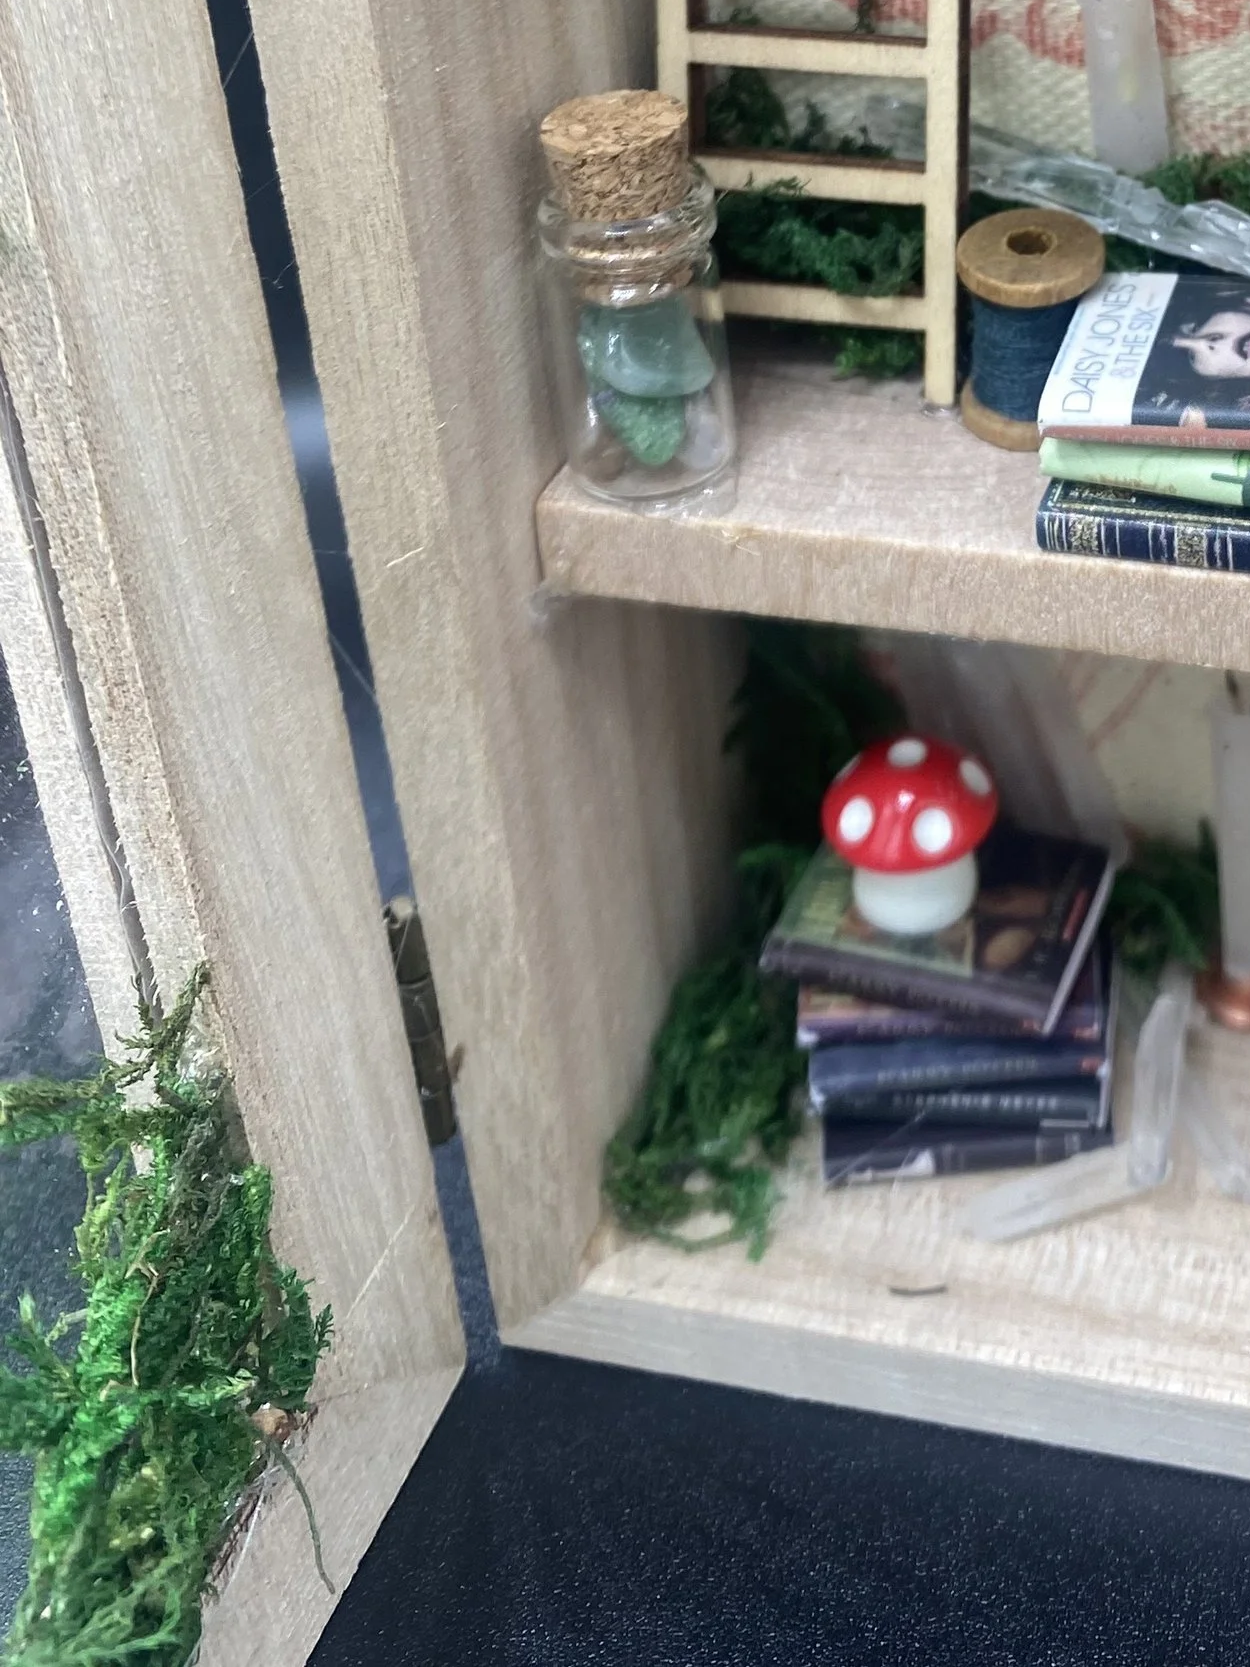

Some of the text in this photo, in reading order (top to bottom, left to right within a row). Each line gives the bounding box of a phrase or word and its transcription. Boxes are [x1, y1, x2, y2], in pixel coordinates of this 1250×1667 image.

[1061, 348, 1109, 414] DAISY
[1087, 283, 1137, 346] JONES
[1110, 306, 1160, 379] & THE SIX
